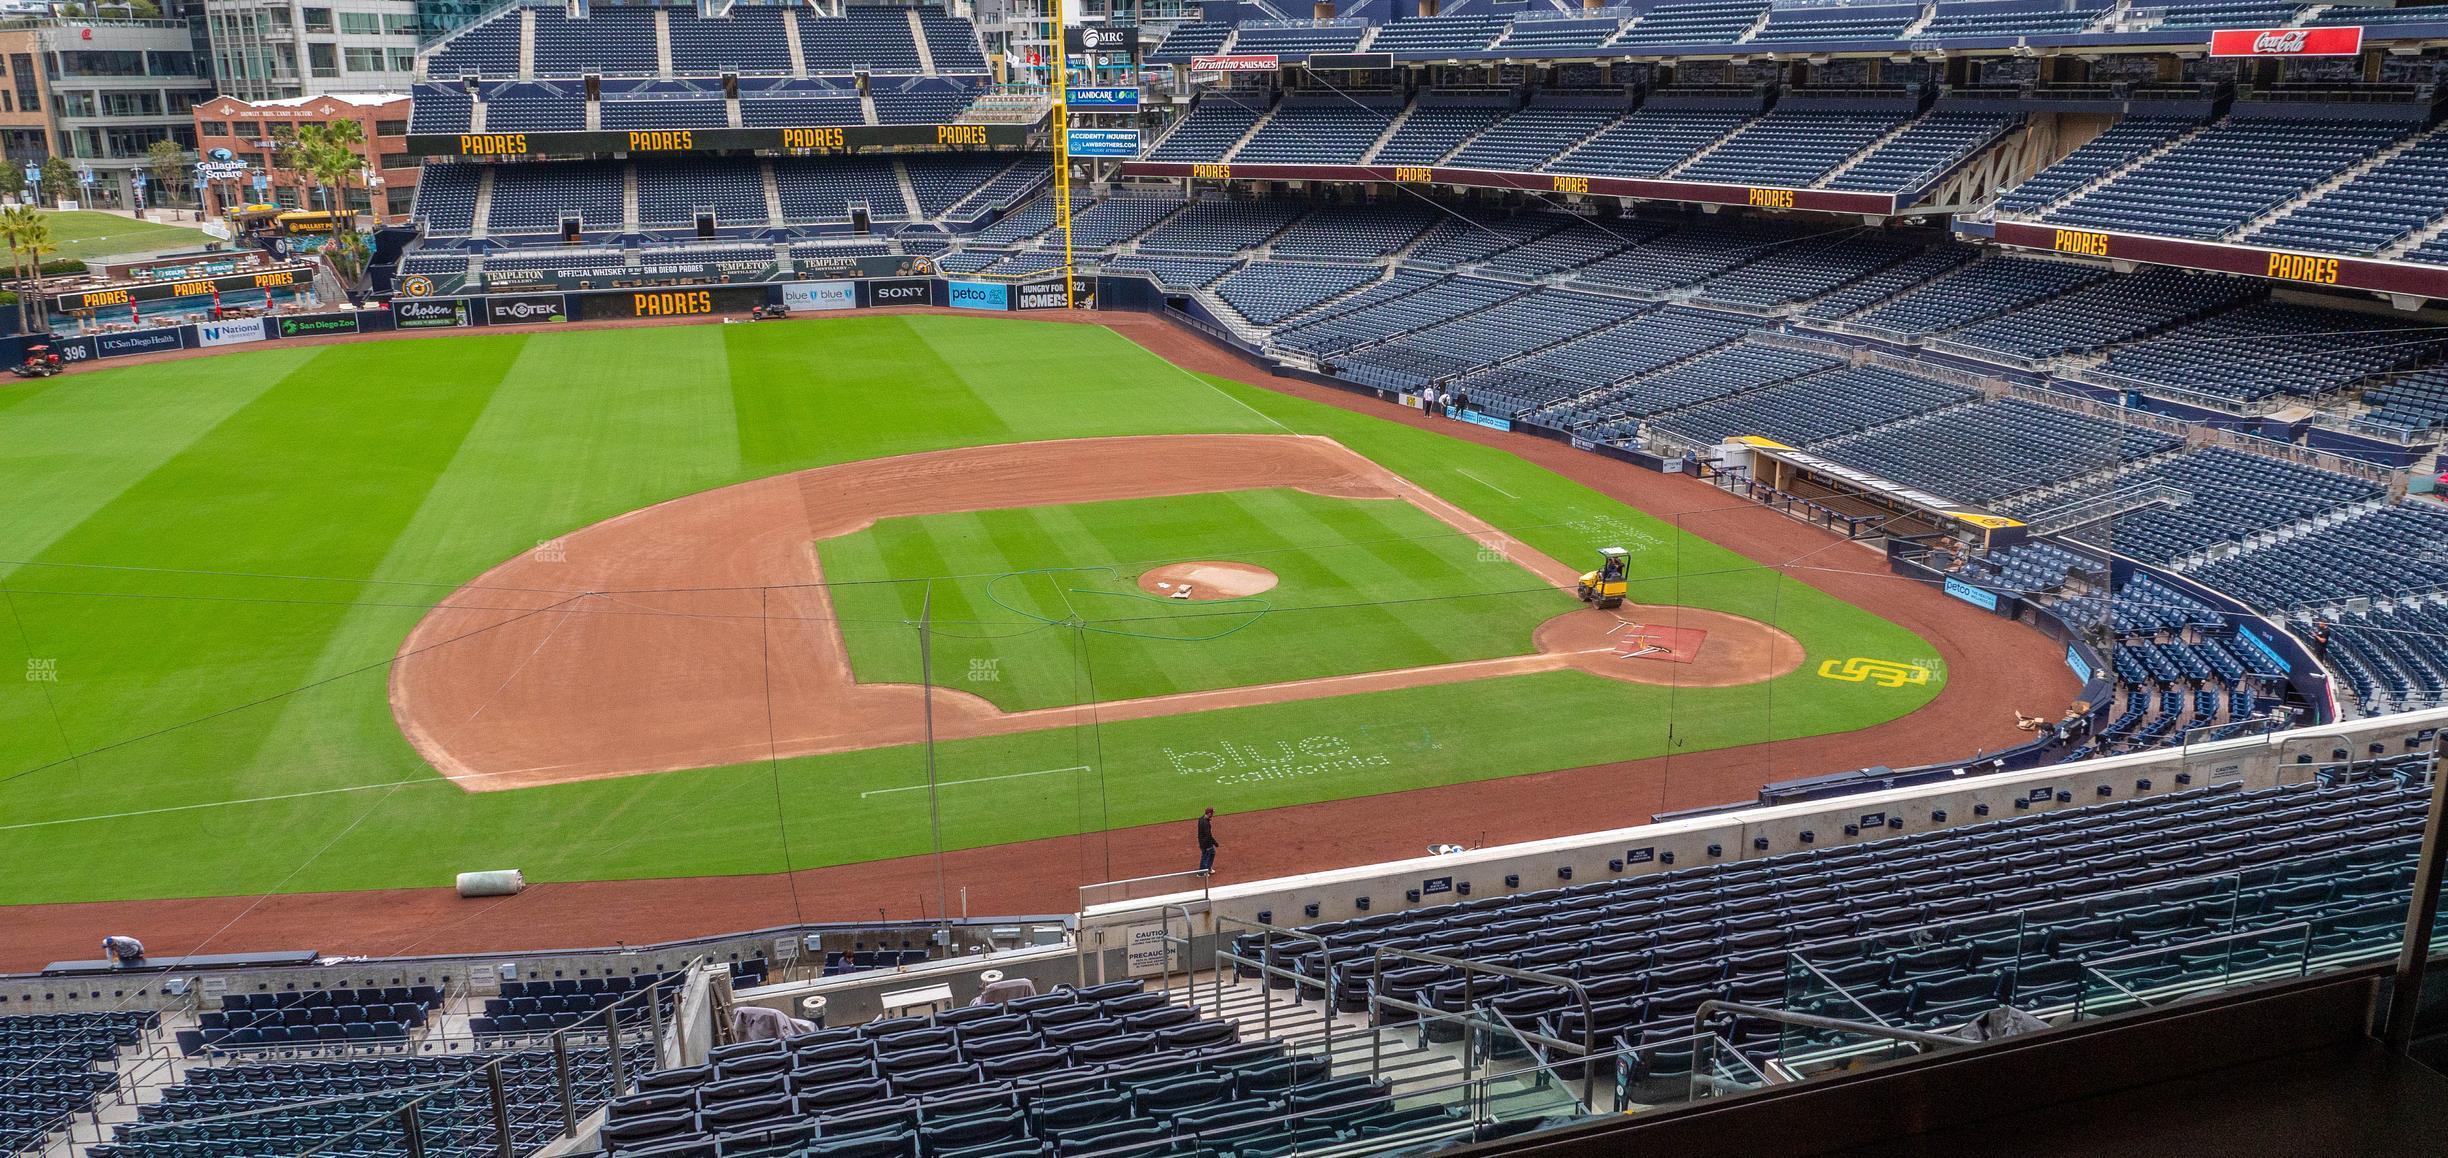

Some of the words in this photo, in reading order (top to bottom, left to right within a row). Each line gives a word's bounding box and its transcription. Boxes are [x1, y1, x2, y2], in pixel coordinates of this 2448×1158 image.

[1099, 32, 1124, 42] MRC
[1193, 58, 1239, 69] Tarantino
[1240, 60, 1276, 69] SAUSAGES
[1078, 91, 1113, 101] LANDCARE
[1115, 91, 1137, 99] LOGIC
[629, 131, 693, 151] PADRES
[784, 128, 844, 147] PADRES
[937, 126, 986, 144] PADRES
[460, 134, 527, 154] PADRES
[197, 161, 248, 172] Gallagher
[1193, 165, 1230, 178] PADRES
[205, 170, 243, 180] Square
[1396, 167, 1432, 182] PADRES
[1554, 176, 1588, 193] PADRES
[1749, 188, 1793, 208] PADRES
[2055, 229, 2108, 256] PADRES
[716, 262, 770, 272] TEMPLETON
[804, 258, 857, 268] TEMPLETON
[2267, 252, 2339, 284] PADRES
[485, 270, 544, 282] TEMPLETON
[558, 269, 592, 278] OFFICIAL
[593, 267, 626, 276] WHISKEY
[644, 266, 658, 274] SAN
[659, 265, 678, 273] DIEGO
[679, 264, 704, 273] PADRES
[255, 272, 293, 287] PADRES
[173, 281, 215, 297] PADRES
[821, 289, 843, 299] blue
[879, 287, 924, 299] SONY
[1022, 285, 1050, 293] HUNGRY
[1051, 284, 1064, 292] FOR
[1072, 282, 1085, 292] 322
[84, 290, 128, 307] PADRES
[785, 290, 808, 300] blue
[952, 288, 986, 301] petco
[1020, 294, 1067, 308] HOMERS
[401, 303, 451, 316] Chosen
[496, 303, 558, 318] EVOTEK
[635, 291, 711, 317] PADRES
[222, 323, 260, 334] National
[300, 322, 315, 330] San
[315, 321, 339, 329] Diego
[104, 340, 115, 349] UC
[116, 338, 129, 348] San
[130, 337, 151, 348] Diego
[151, 334, 175, 345] Health
[63, 345, 87, 360] 396
[1946, 581, 1970, 595] petco
[1163, 735, 1350, 775] blue
[1216, 752, 1391, 785] california
[1129, 948, 1176, 959] PRECAUCN
